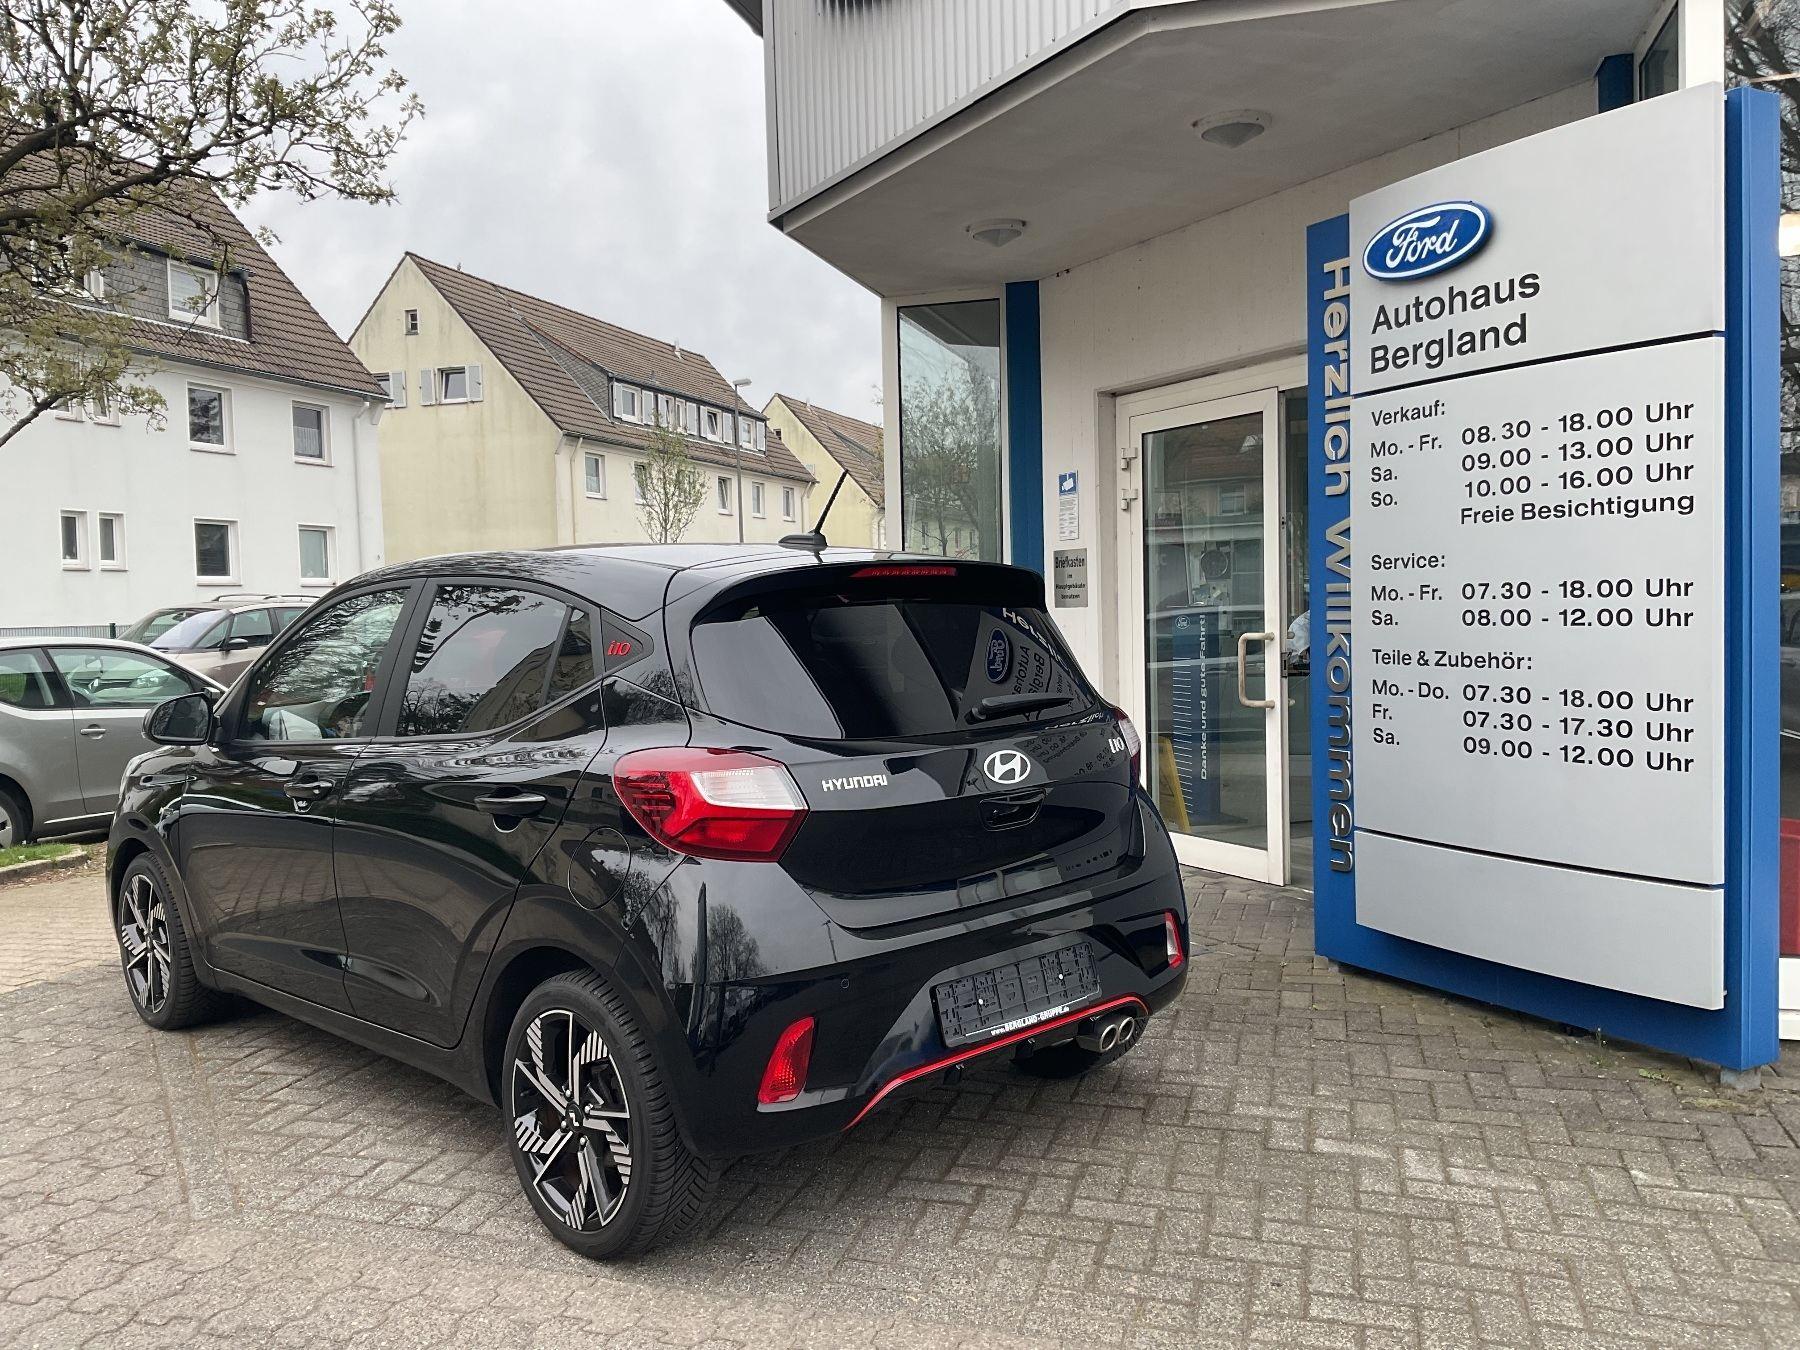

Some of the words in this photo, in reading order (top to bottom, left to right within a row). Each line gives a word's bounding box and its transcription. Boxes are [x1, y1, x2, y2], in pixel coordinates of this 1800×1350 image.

[1385, 215, 1460, 269] Ford
[1371, 273, 1540, 335] Autohaus
[1370, 312, 1527, 375] Bergland
[1323, 256, 1350, 497] Herzlich
[1370, 440, 1403, 459] Mo.
[1418, 433, 1442, 451] Fr.
[1461, 420, 1531, 445] 08.30
[1558, 406, 1633, 433] 18.00
[1645, 401, 1694, 423] Uhr
[1371, 400, 1445, 427] Verkauf:
[1370, 467, 1398, 483] Sa.
[1461, 447, 1531, 472] 09.00
[1558, 436, 1633, 462] 13.00
[1645, 432, 1694, 453] Uhr
[1370, 490, 1398, 508] So.
[1464, 475, 1531, 498] 10.00
[1558, 465, 1633, 490] 16.00
[1645, 462, 1694, 483] Uhr
[1461, 507, 1515, 525] Freie
[1520, 495, 1695, 521] Besichtigung
[1055, 556, 1085, 569] Briefkasten
[1371, 552, 1446, 571] Service:
[1371, 585, 1404, 602] Mo.
[1418, 584, 1443, 601] Fr.
[1461, 581, 1532, 600] 07.30
[1558, 578, 1633, 599] 18.00
[1645, 578, 1694, 598] Uhr
[1371, 609, 1399, 626] Sa.
[1461, 608, 1532, 627] 08.00
[1558, 607, 1633, 627] 12.00
[1645, 608, 1694, 627] Uhr
[607, 640, 631, 656] i10
[1371, 648, 1412, 666] Teile
[1416, 650, 1430, 667] &
[1433, 650, 1532, 670] Zubehör:
[1200, 662, 1208, 698] gute
[1325, 518, 1353, 873] Willkommen
[1371, 679, 1404, 697] Mo.
[1418, 681, 1449, 700] Do.
[1462, 683, 1532, 705] 07.30
[1558, 688, 1634, 710] 18.00
[1646, 692, 1694, 713] Uhr
[1199, 700, 1207, 729] und
[1372, 703, 1393, 720] Fr.
[1462, 710, 1532, 732] 07.30
[1559, 717, 1634, 739] 17.30
[1646, 721, 1694, 743] Uhr
[1108, 736, 1125, 754] i10
[1199, 732, 1208, 780] Danke
[1373, 727, 1400, 746] Sa.
[1463, 736, 1533, 759] 09.00
[1559, 744, 1634, 768] 12.00
[1646, 751, 1695, 773] Uhr
[822, 774, 888, 792] HYUNDAI
